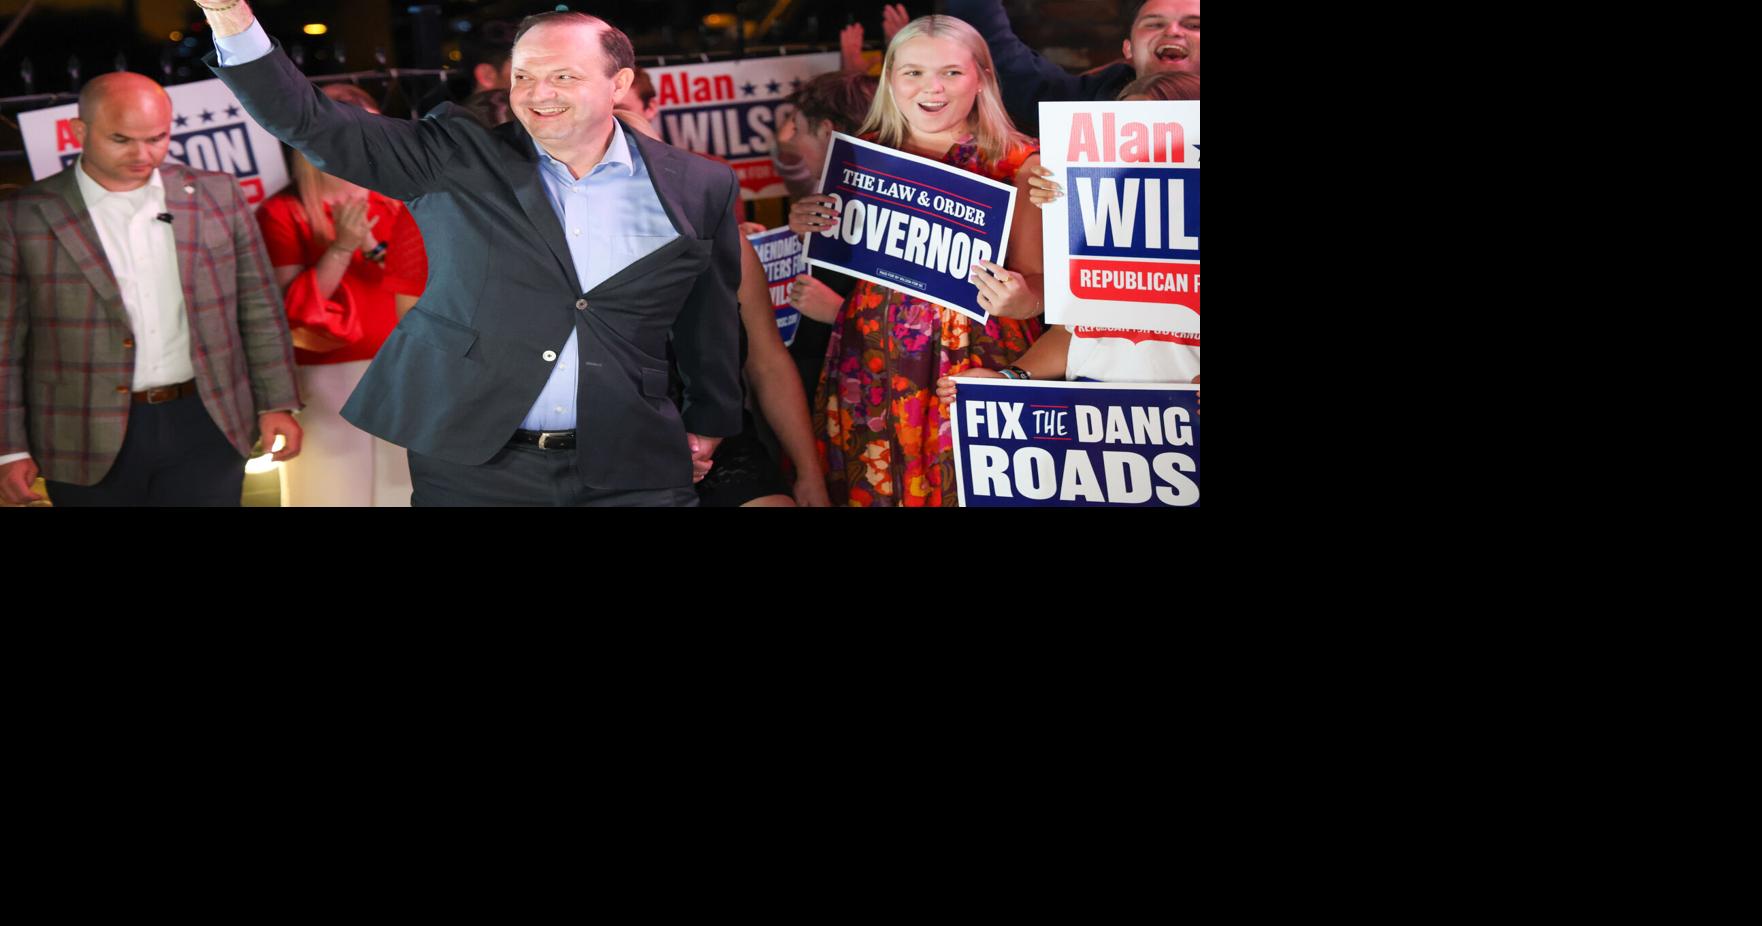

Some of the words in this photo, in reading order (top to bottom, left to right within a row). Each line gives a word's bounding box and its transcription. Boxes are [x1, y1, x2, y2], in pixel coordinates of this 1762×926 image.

[659, 71, 736, 106] Alan
[1066, 112, 1185, 163] Alan
[842, 168, 875, 191] THE
[876, 179, 917, 202] LAW
[916, 191, 931, 208] &
[933, 195, 987, 226] ORDER
[1080, 268, 1189, 293] REPUBLICAN
[965, 400, 1028, 440] FIX
[1032, 409, 1069, 437] THE
[1074, 404, 1194, 446] DANG
[968, 444, 1200, 507] ROADS
